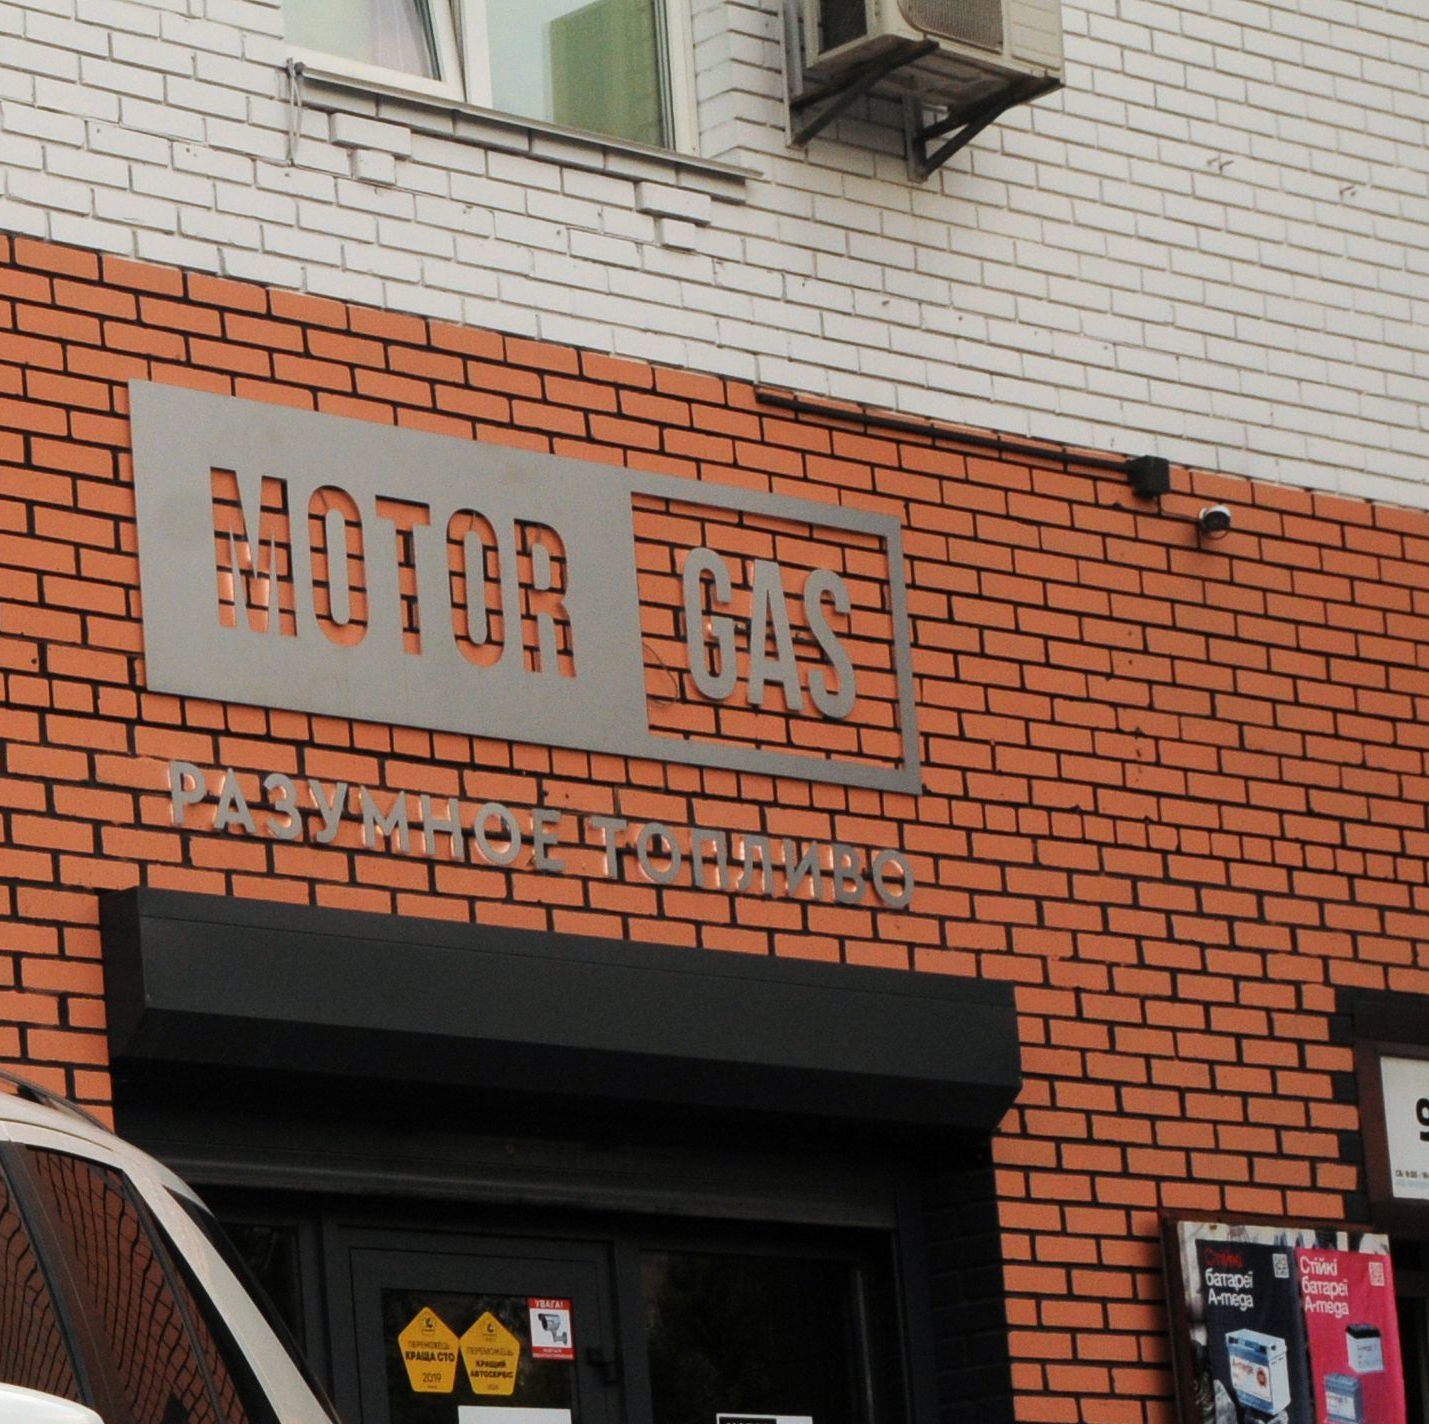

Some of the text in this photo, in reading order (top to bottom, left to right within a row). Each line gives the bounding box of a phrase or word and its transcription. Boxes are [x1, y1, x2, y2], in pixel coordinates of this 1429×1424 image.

[208, 465, 856, 720] MOTOR GAS
[167, 760, 915, 910] РАЗУМНОЕ ТОПЛИВО
[1299, 1255, 1338, 1276] Стійкі
[1205, 1267, 1253, 1290] батареї
[1301, 1276, 1349, 1300] батареї
[534, 1300, 564, 1309] УВАГА!
[438, 1352, 455, 1363] СТО
[422, 1373, 442, 1383] 2019
